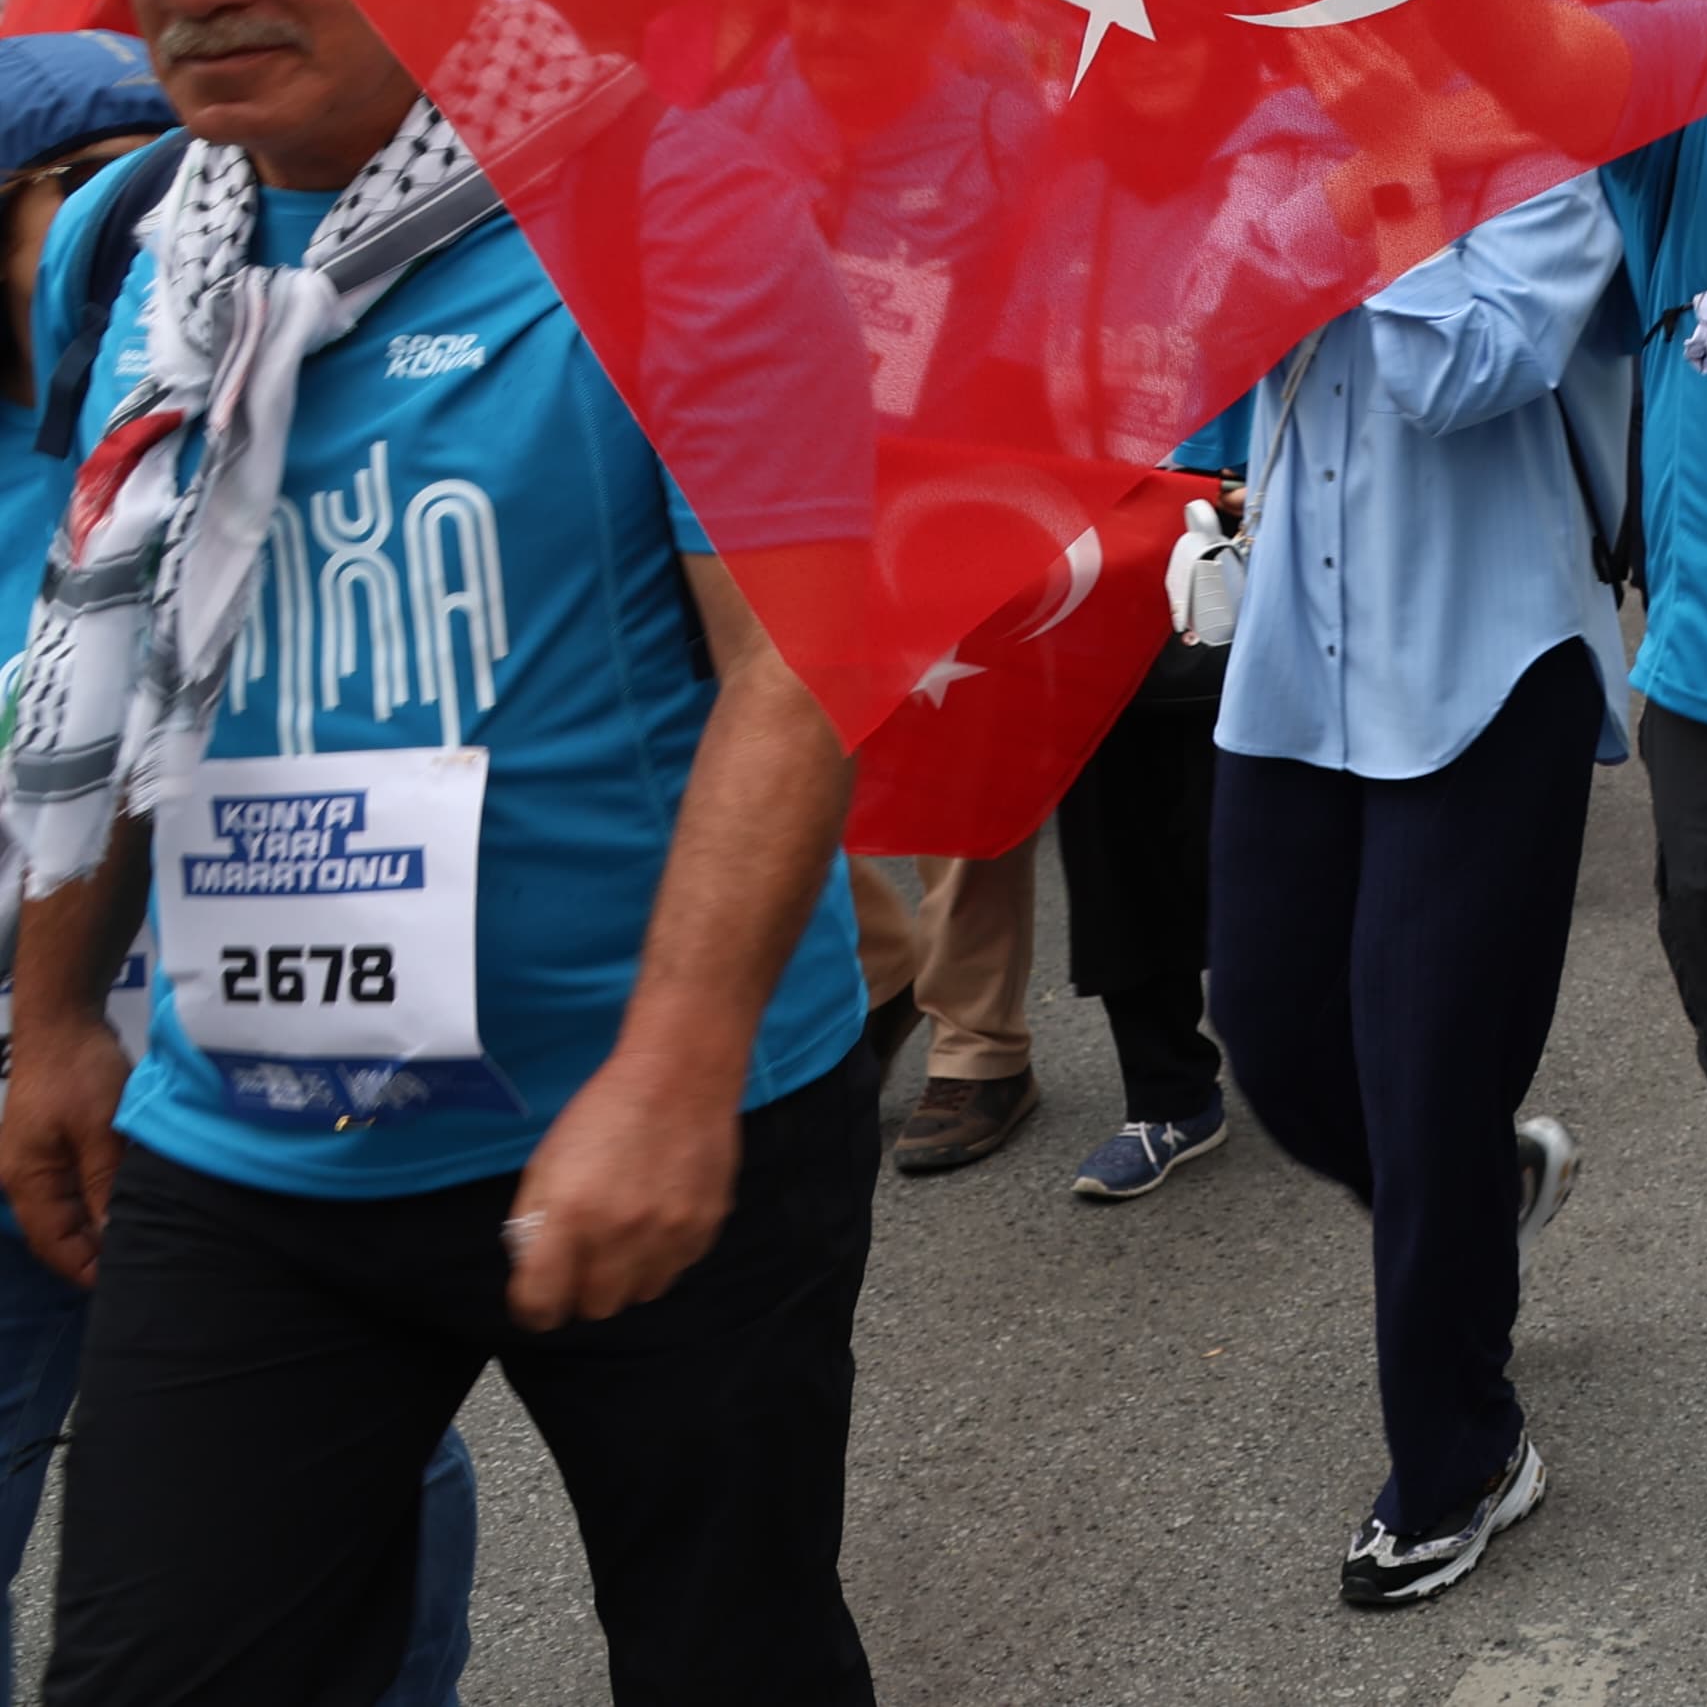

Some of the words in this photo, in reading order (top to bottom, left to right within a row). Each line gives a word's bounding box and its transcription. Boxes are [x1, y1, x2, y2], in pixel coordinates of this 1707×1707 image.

[220, 796, 358, 836] KONYA
[242, 829, 334, 861] YARI
[190, 853, 411, 894] MARATONU
[221, 946, 397, 1003] 2678
